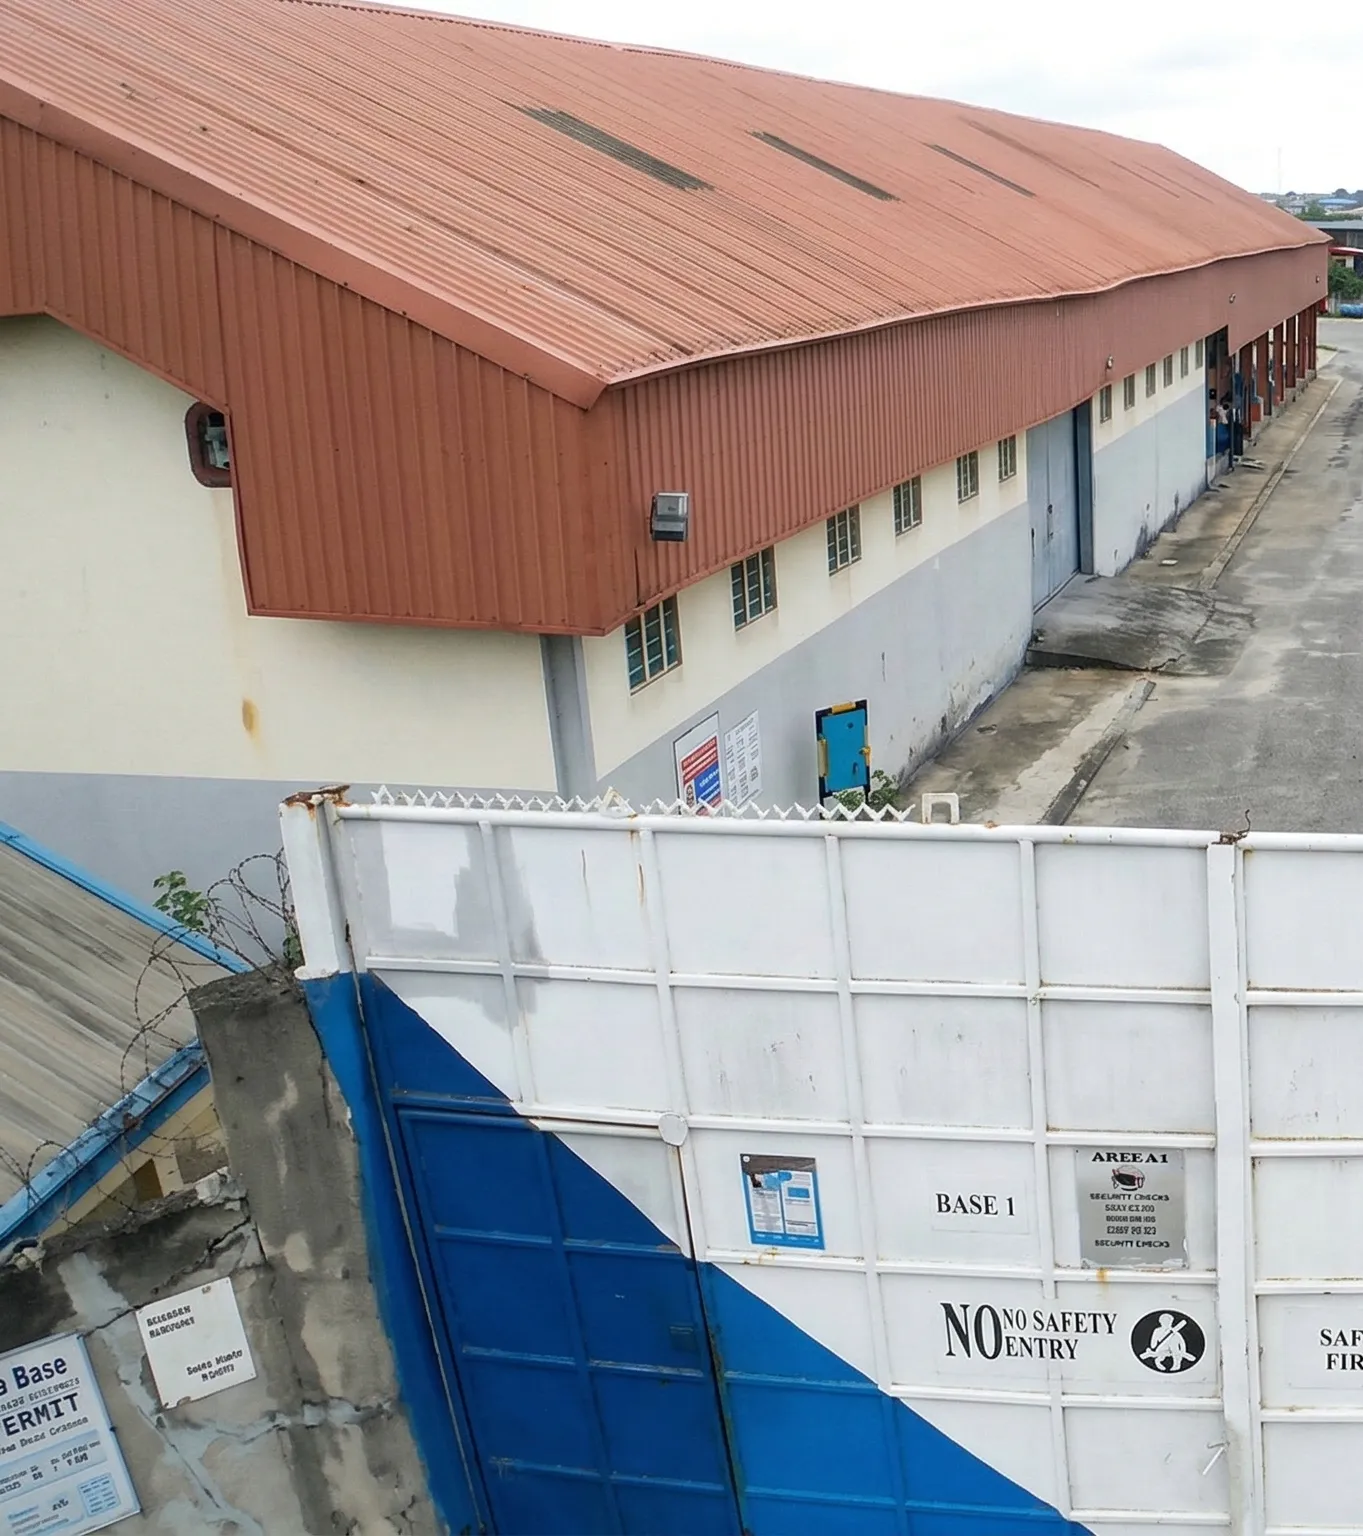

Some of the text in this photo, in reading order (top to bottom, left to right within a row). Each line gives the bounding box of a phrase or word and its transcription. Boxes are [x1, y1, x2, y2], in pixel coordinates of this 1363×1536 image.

[935, 1193, 1015, 1217] BASE 1
[940, 1302, 1002, 1360] NO
[1002, 1308, 1118, 1334] NO SAFETY
[1005, 1336, 1079, 1360] ENTRY
[12, 1357, 68, 1390] Base
[0, 1392, 79, 1436] ERMIT
